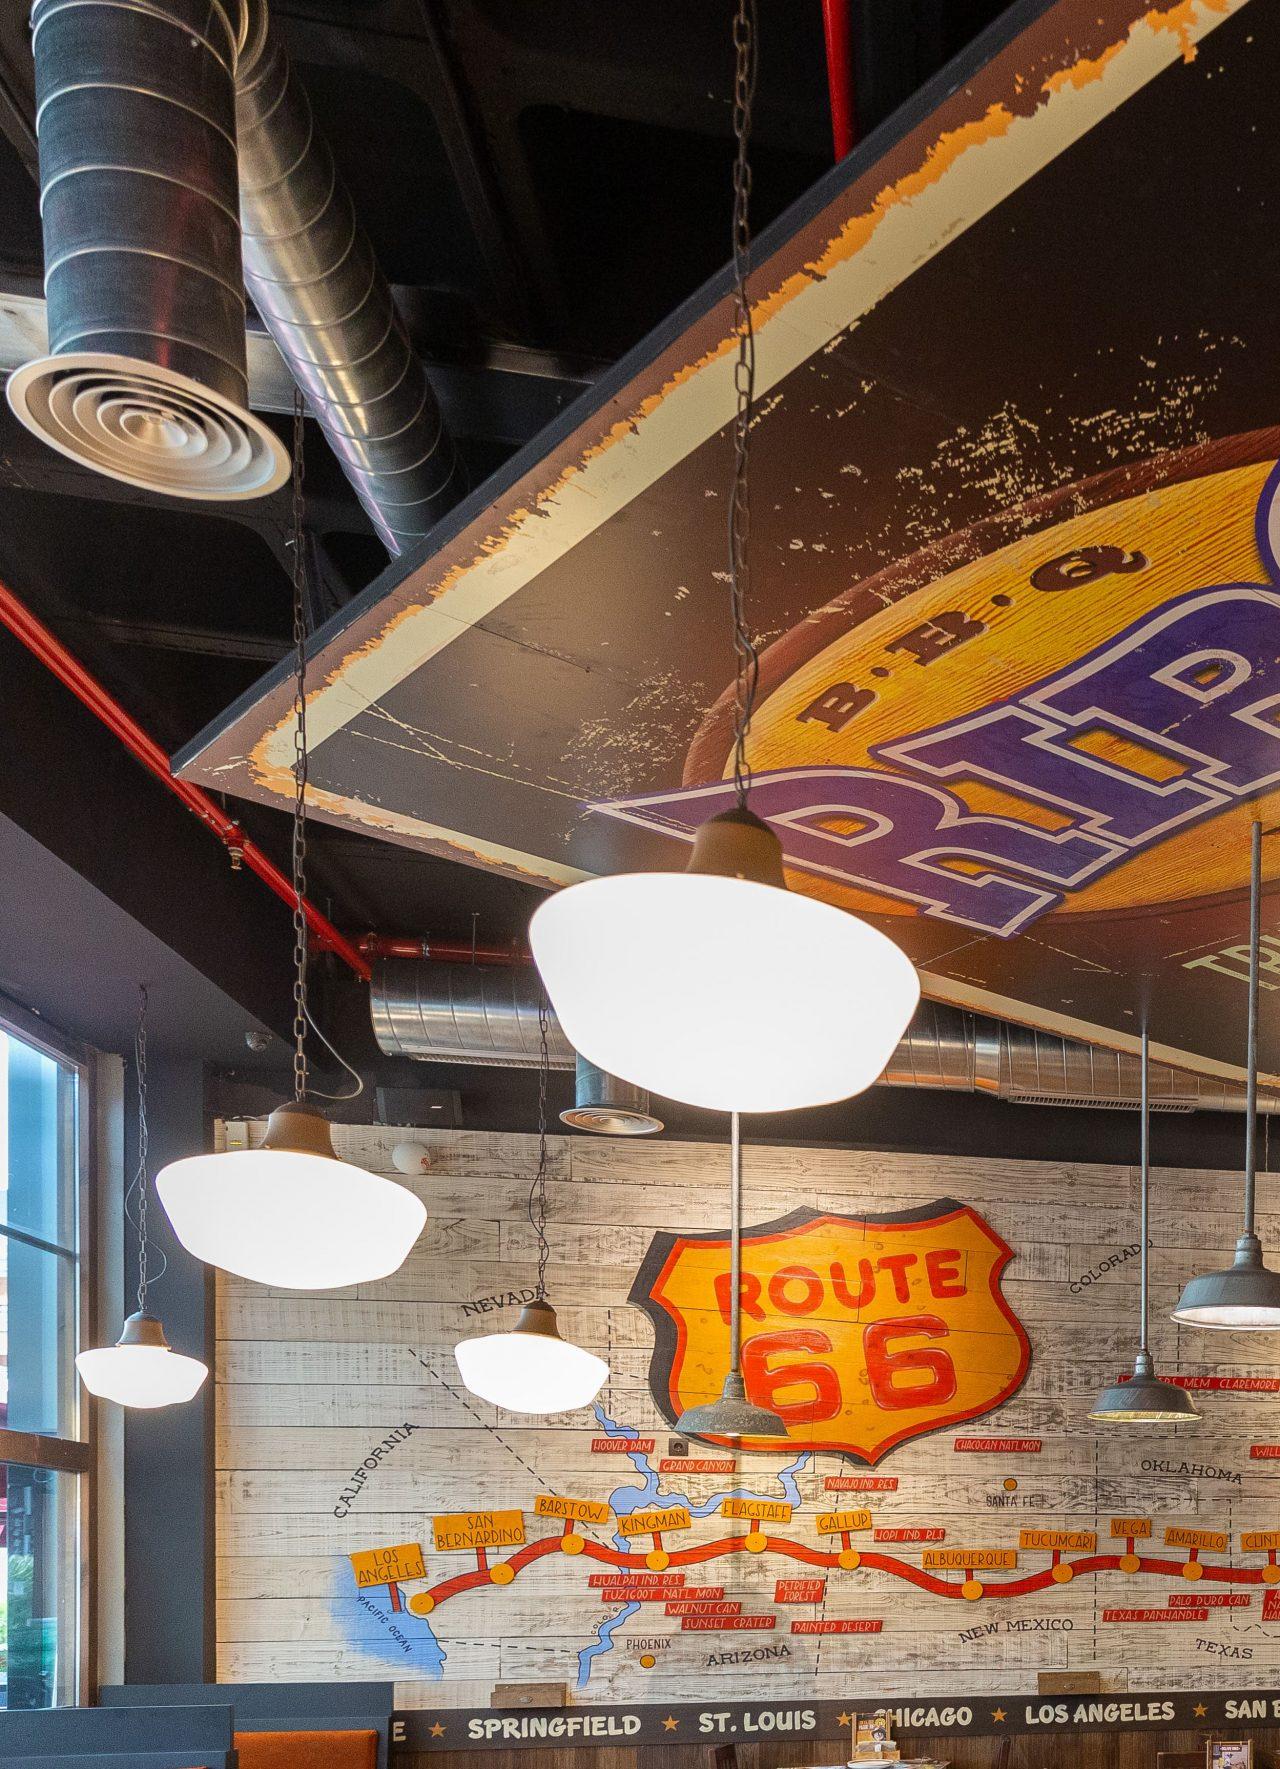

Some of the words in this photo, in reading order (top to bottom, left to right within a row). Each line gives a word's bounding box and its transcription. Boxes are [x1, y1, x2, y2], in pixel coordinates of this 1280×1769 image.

[714, 1248, 968, 1326] ROUTE
[461, 1286, 550, 1318] NEVADA
[741, 1313, 957, 1427] 66
[1184, 1378, 1210, 1388] MEM
[1219, 1379, 1277, 1390] CLAREMORE
[593, 1440, 627, 1450] HOOVER
[630, 1440, 652, 1451] DAM
[1022, 1441, 1041, 1450] MON
[1255, 1447, 1280, 1457] WILL
[333, 1421, 420, 1519] CALIFORNIA
[662, 1461, 695, 1471] GRAND
[696, 1461, 734, 1472] CANYON
[1141, 1460, 1242, 1485] OKLAHOMA
[827, 1479, 859, 1490] NAVAJO
[986, 1495, 1017, 1507] SANTA
[1023, 1496, 1035, 1507] FE
[539, 1499, 604, 1520] BARSTOW
[723, 1500, 791, 1519] FLAGSTAFF
[467, 1515, 494, 1530] SAN
[621, 1512, 686, 1532] KINGMAN
[820, 1514, 868, 1530] GALLUP
[1113, 1521, 1147, 1535] VEGA
[437, 1528, 523, 1548] BERNARDINO
[1024, 1532, 1093, 1549] TUCUMCARI
[1167, 1529, 1224, 1548] AMARILLO
[373, 1549, 399, 1566] LOS
[924, 1552, 1010, 1566] ALBUQUERQUE
[358, 1560, 423, 1585] ANGELES
[593, 1575, 639, 1586] HUALPAI
[778, 1581, 821, 1591] PETRIFIED
[604, 1589, 655, 1600] TUZIGOOT
[696, 1588, 721, 1598] MON
[784, 1591, 816, 1601] FOREST
[1170, 1596, 1192, 1605] PALO
[1197, 1595, 1223, 1605] DURO
[1228, 1595, 1249, 1605] CAN
[667, 1604, 713, 1615] WALNUT
[716, 1603, 739, 1614] CAN
[1105, 1611, 1138, 1621] TEXAS
[1143, 1610, 1203, 1621] PANHANDLE
[356, 1595, 389, 1625] PACIFIC
[388, 1625, 413, 1653] OCEAN
[685, 1618, 725, 1629] SUNSET
[734, 1618, 772, 1628] CRATER
[794, 1622, 837, 1632] PAINTED
[841, 1621, 879, 1632] DESERT
[958, 1622, 1000, 1644] NEW
[1007, 1618, 1073, 1632] MEXICO
[626, 1638, 672, 1650] PHOENIX
[1195, 1638, 1253, 1659] TEXAS
[705, 1644, 792, 1668] ARIZONA
[468, 1714, 641, 1740] SPRINGFIELD
[699, 1712, 737, 1733] ST.
[743, 1709, 816, 1732] LOUIS
[1025, 1705, 1070, 1725] LOS
[1073, 1702, 1175, 1724] ANGELES
[1225, 1700, 1266, 1719] SAN
